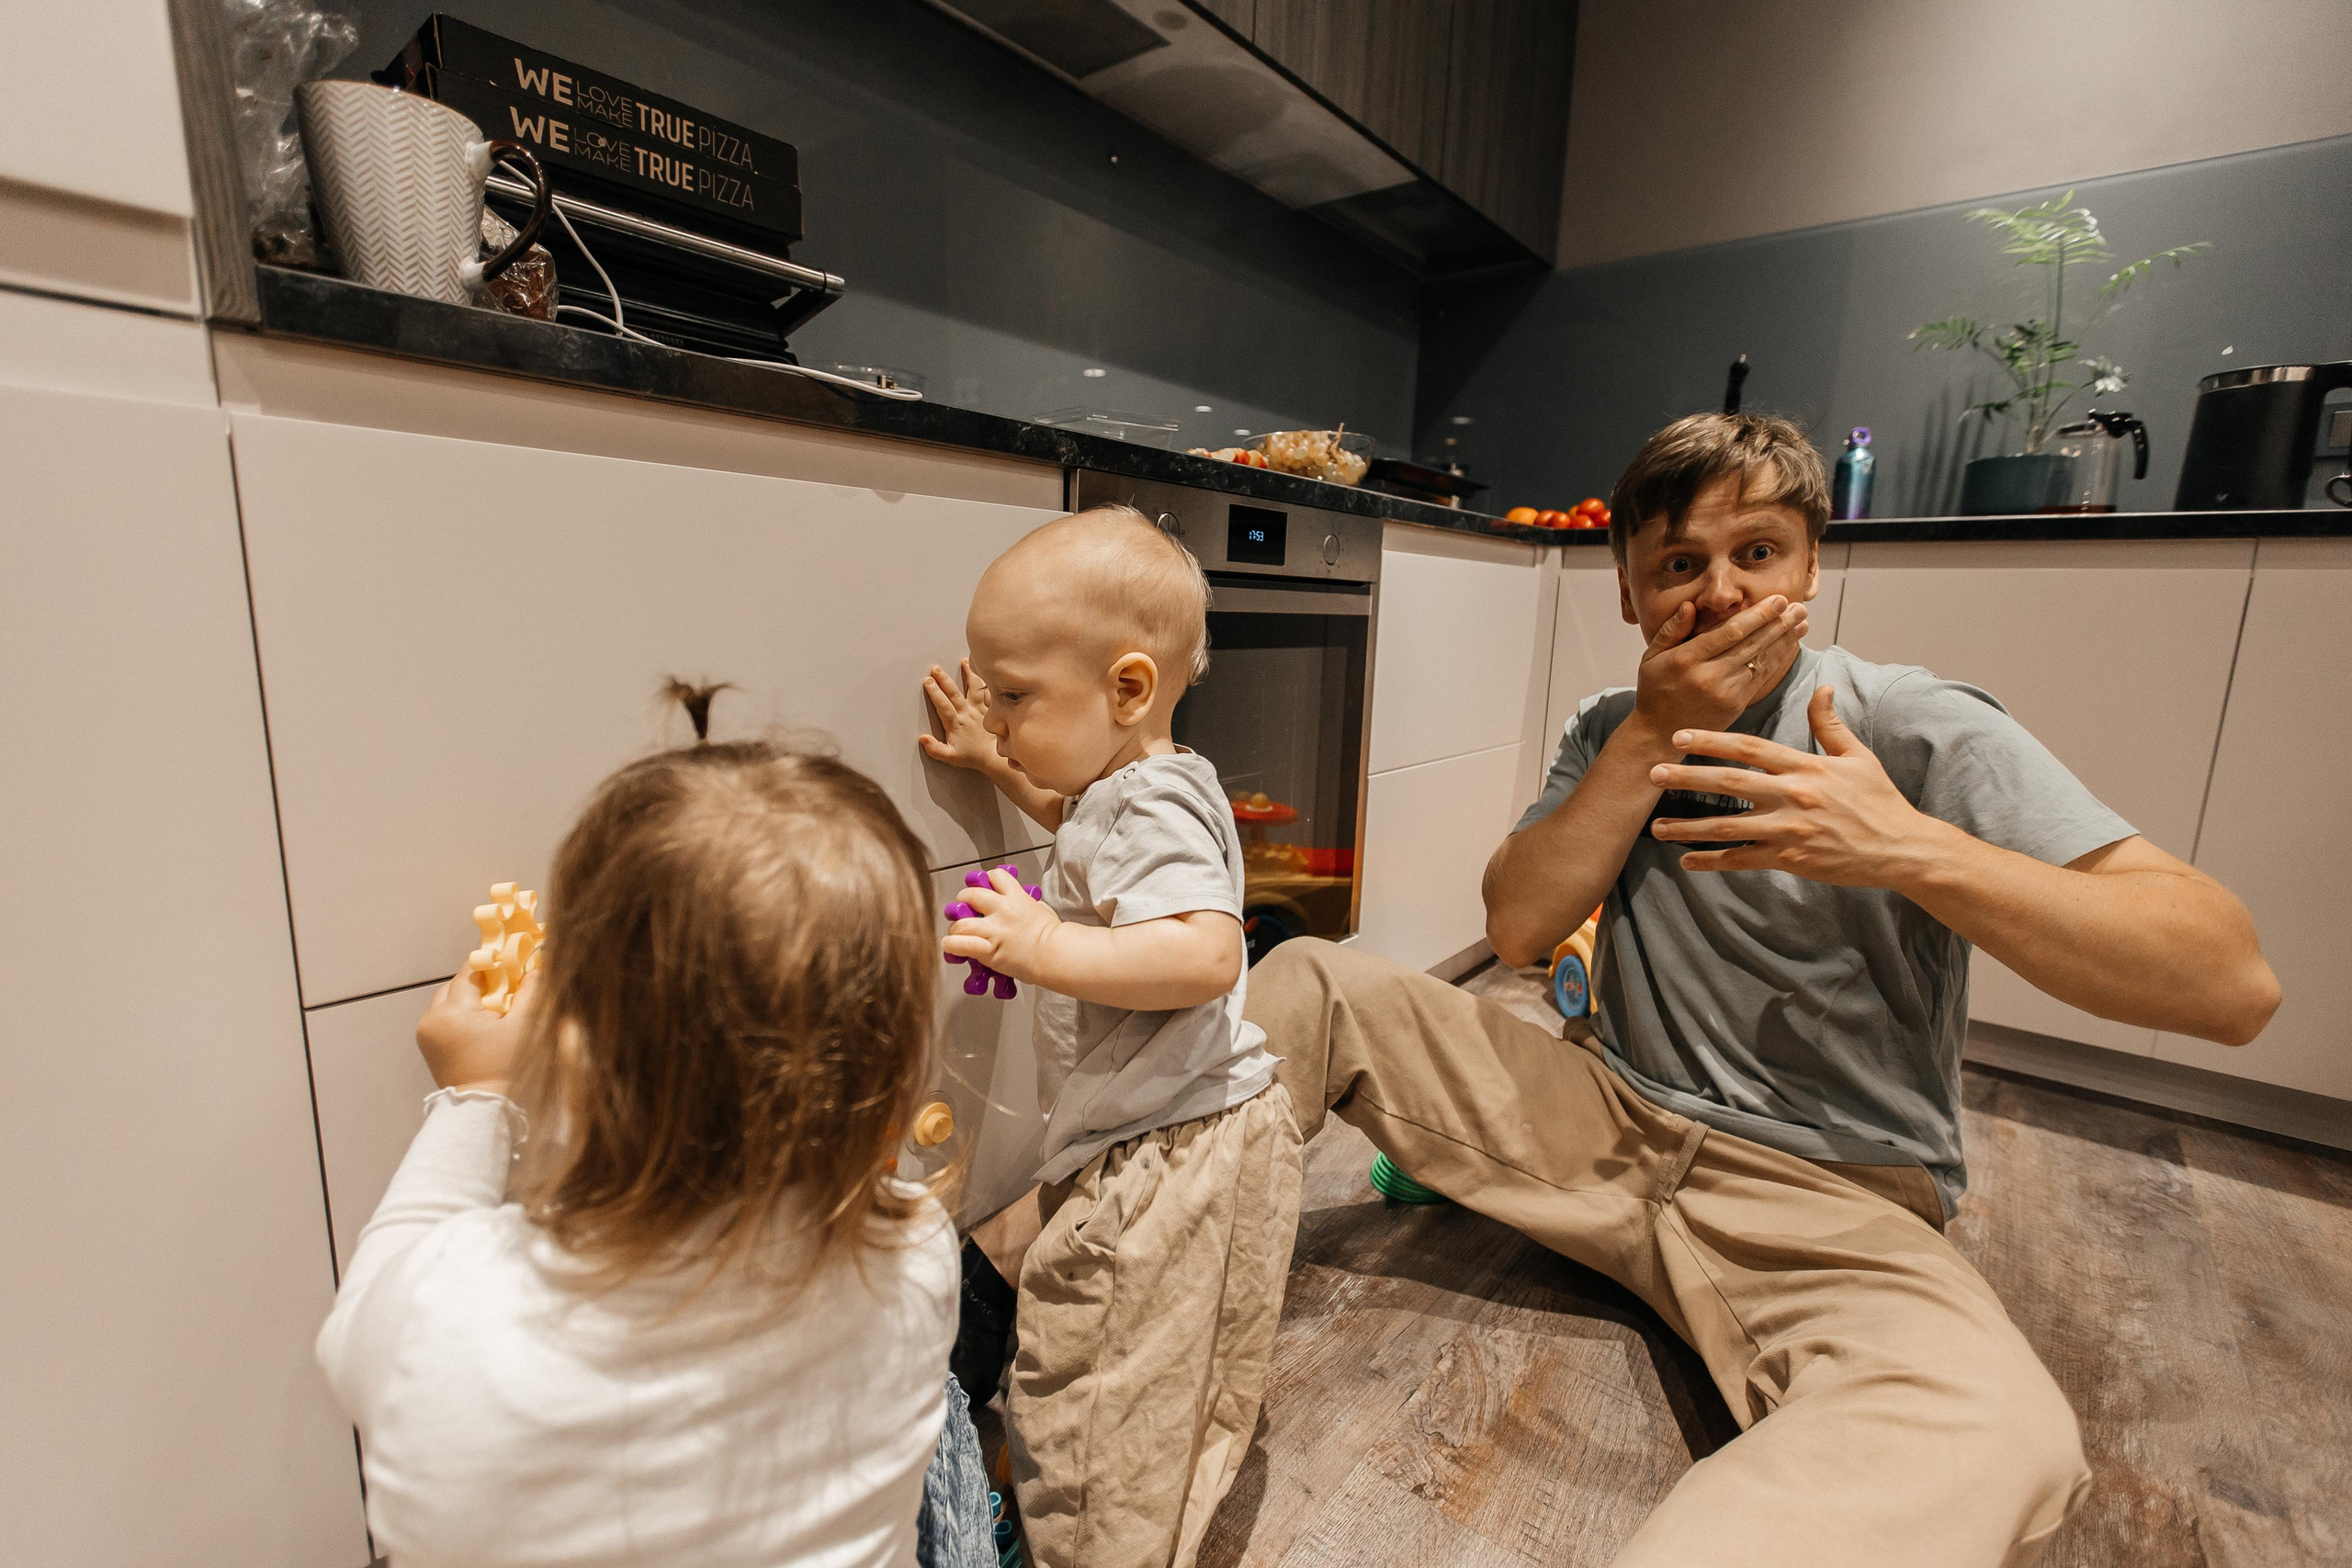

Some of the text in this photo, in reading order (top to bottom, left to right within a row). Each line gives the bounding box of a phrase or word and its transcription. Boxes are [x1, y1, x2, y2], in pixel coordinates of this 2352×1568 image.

[514, 57, 755, 170] WE LOVE TRUE PIZZA
[577, 95, 633, 129] MAKE
[509, 106, 754, 211] WE LOVE TRUE PIZZA
[574, 142, 632, 174] MAKE
